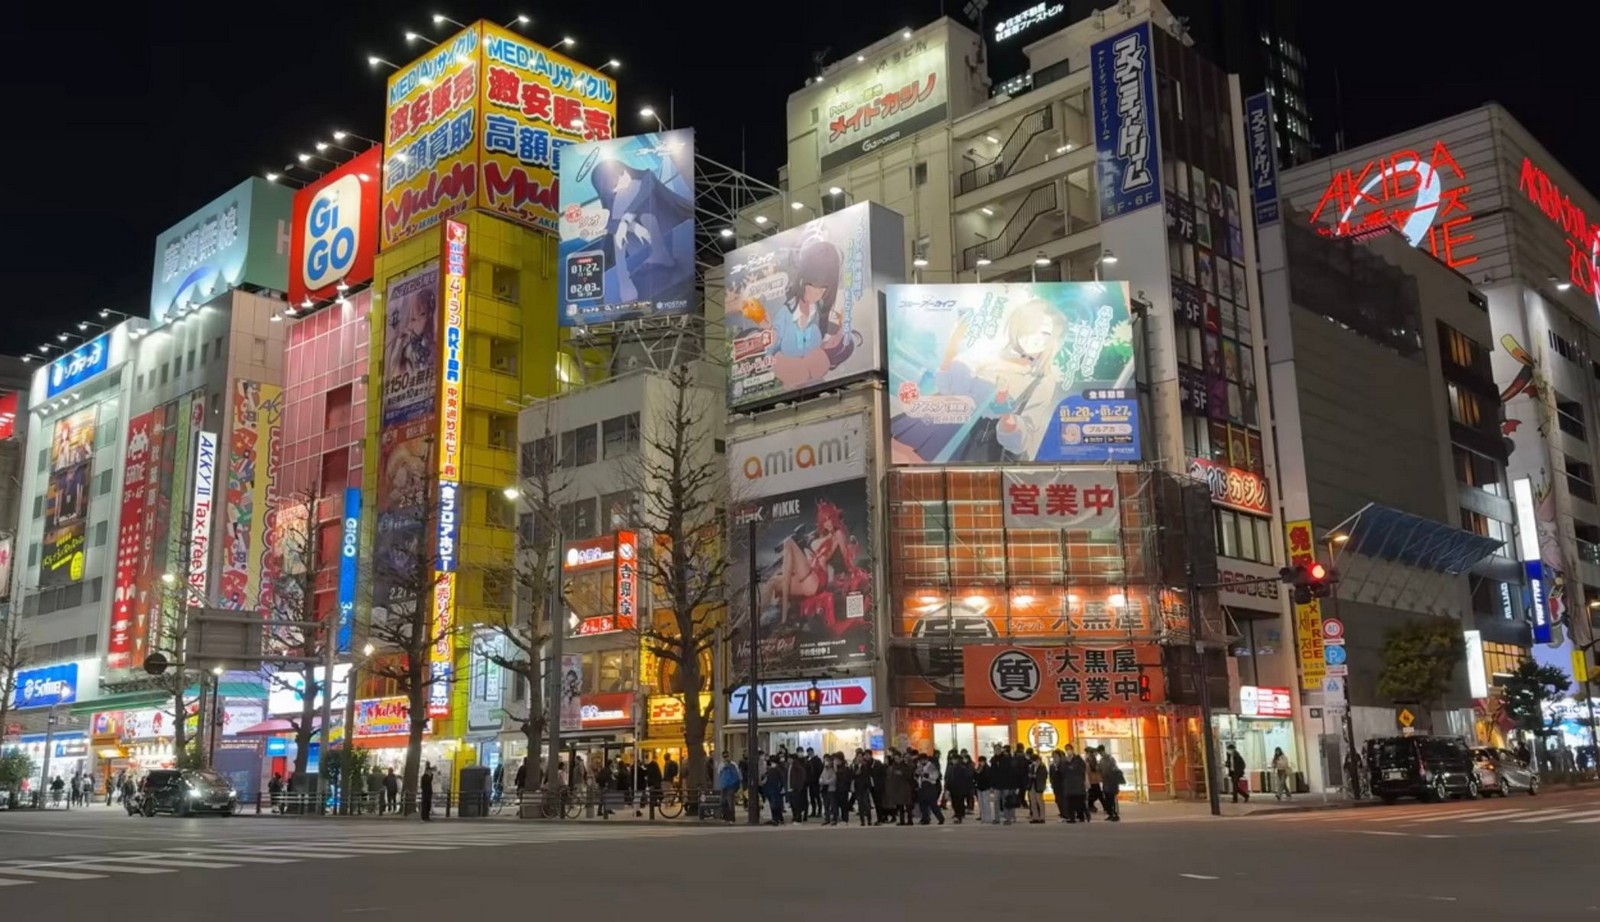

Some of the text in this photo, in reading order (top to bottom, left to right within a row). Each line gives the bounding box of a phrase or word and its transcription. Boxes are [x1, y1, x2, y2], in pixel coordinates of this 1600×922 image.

[388, 62, 478, 146] 激安販売
[487, 66, 612, 141] 激安販売
[829, 73, 936, 143] メイドカジノ
[385, 108, 475, 192] 高額買取
[1308, 140, 1466, 225] AKIBA
[498, 203, 538, 222] ムーラン
[307, 226, 354, 281] GO
[199, 434, 214, 484] AKKY
[743, 435, 849, 480] amiami
[772, 499, 800, 518] NIKKE
[1009, 484, 1115, 517] 営業中
[620, 563, 632, 615] 吉野家
[1532, 579, 1545, 626] GALLERIA
[1051, 601, 1145, 631] 大黒屋
[995, 657, 1035, 696] 質
[1055, 648, 1140, 675] 大黒屋
[734, 687, 767, 715] ZN
[771, 689, 842, 708] COMI ZIN
[1056, 677, 1140, 704] 営業中
